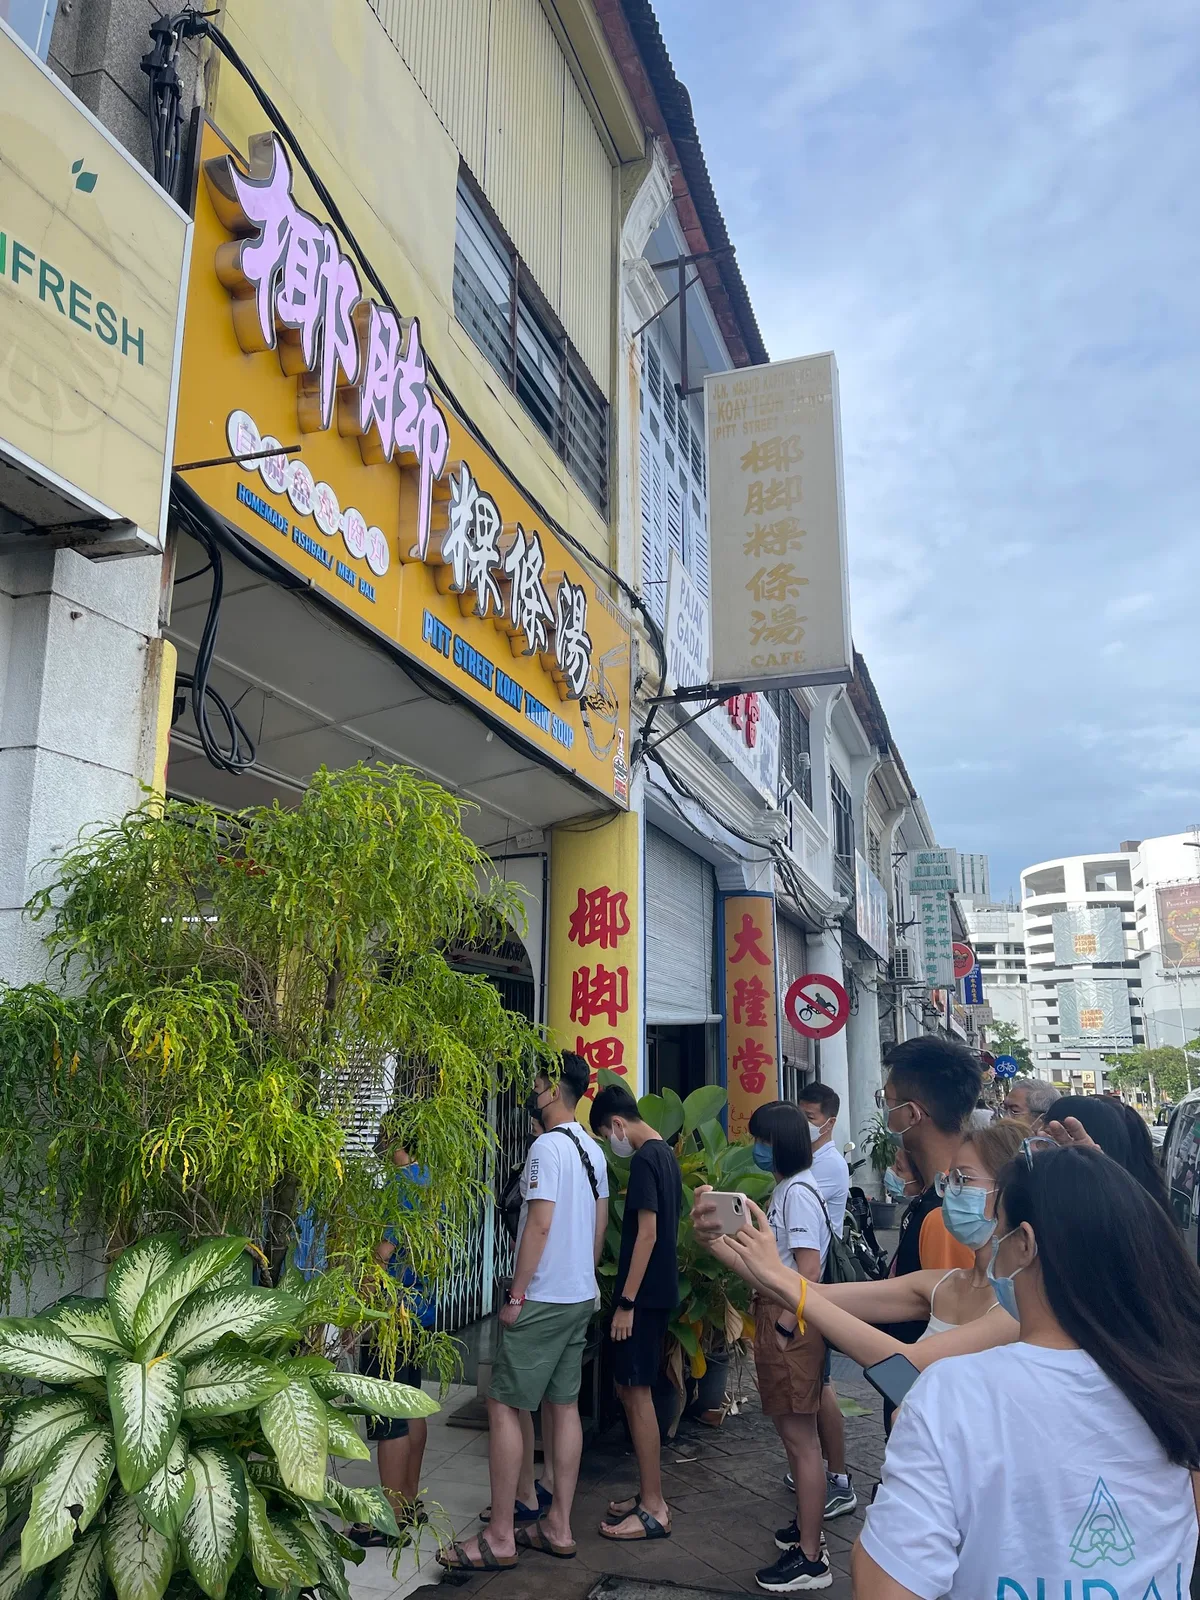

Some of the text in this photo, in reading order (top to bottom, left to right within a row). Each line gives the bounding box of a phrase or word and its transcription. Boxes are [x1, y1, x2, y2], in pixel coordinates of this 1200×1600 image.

[717, 397, 748, 423] KOAY
[237, 482, 288, 536] HOMEMADE
[336, 559, 357, 587] MEAT
[358, 576, 376, 603] BALL
[422, 608, 574, 751] PITT STREET KOAY TEOW SOUP
[750, 649, 807, 669] CAFE
[728, 913, 774, 1095] 大隆當
[530, 1158, 540, 1181] HERO
